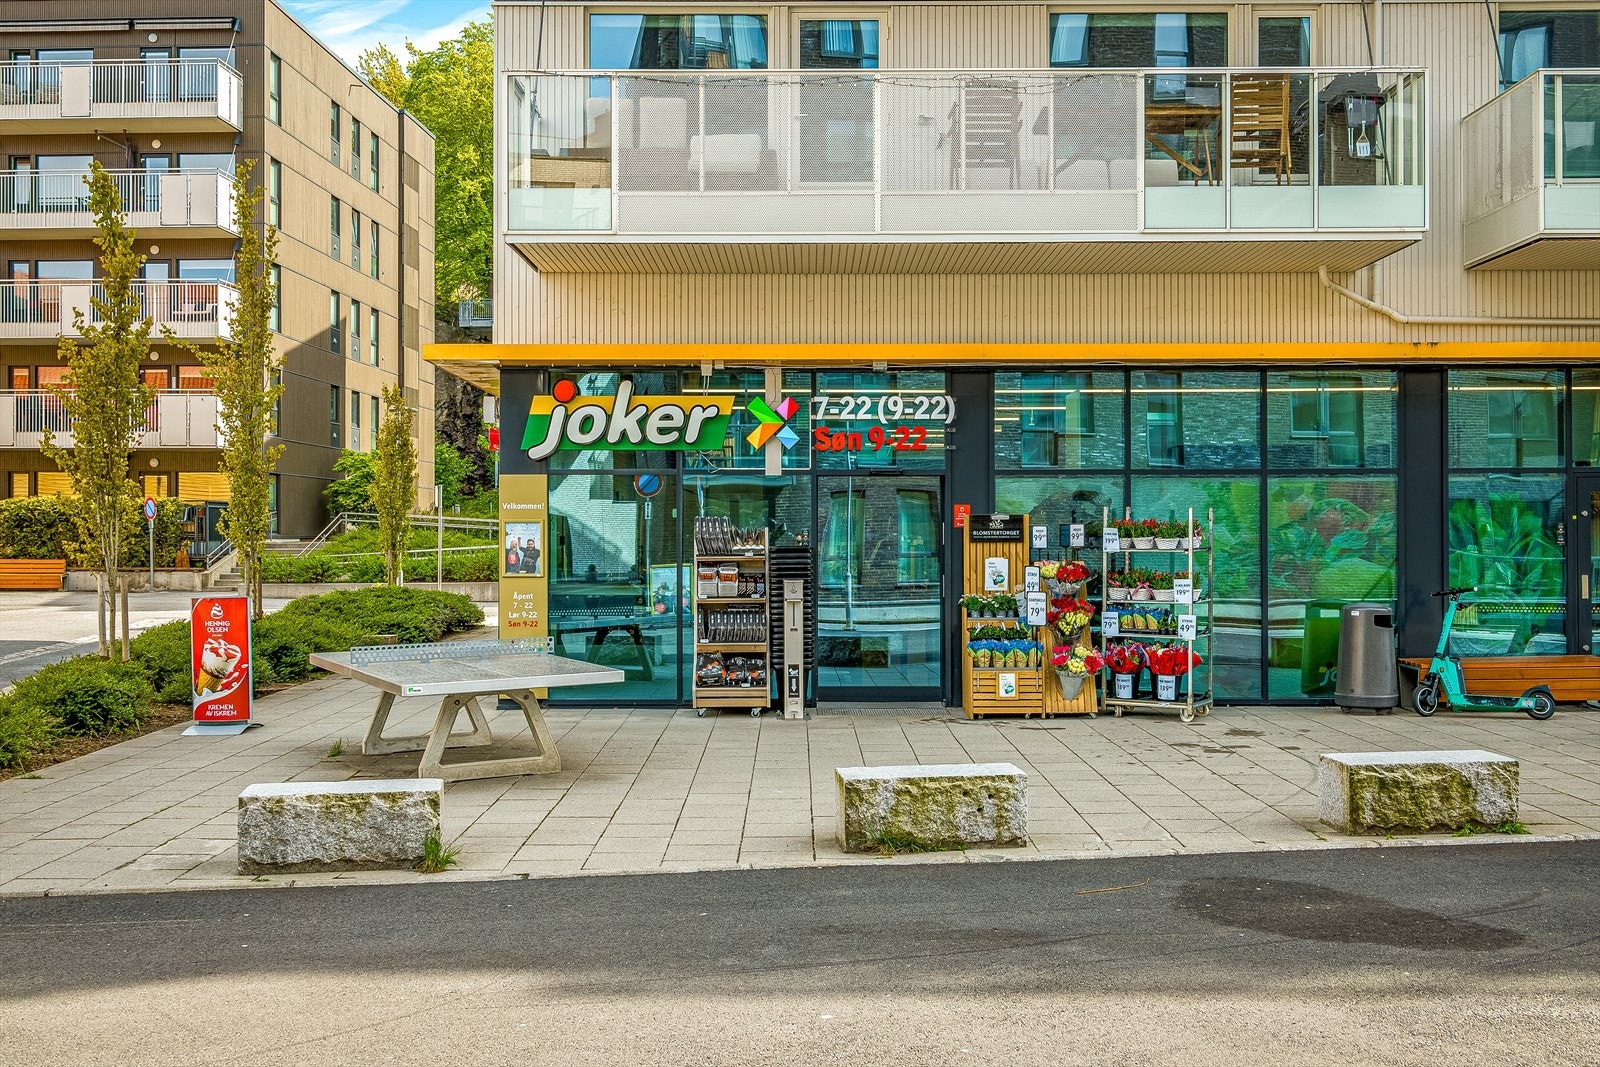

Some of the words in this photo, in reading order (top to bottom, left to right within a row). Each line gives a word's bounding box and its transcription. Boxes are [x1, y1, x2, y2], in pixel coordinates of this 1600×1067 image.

[814, 395, 873, 421] 7-22
[877, 395, 956, 424] (9-22)
[527, 379, 720, 461] joker
[814, 426, 862, 452] Søn
[873, 426, 928, 452] 9-22
[502, 501, 545, 511] Velkommen!
[512, 591, 534, 602] Åpent
[508, 611, 520, 619] Lør
[521, 611, 538, 619] 9-22
[508, 620, 521, 628] Søn
[522, 620, 539, 628] 9-22
